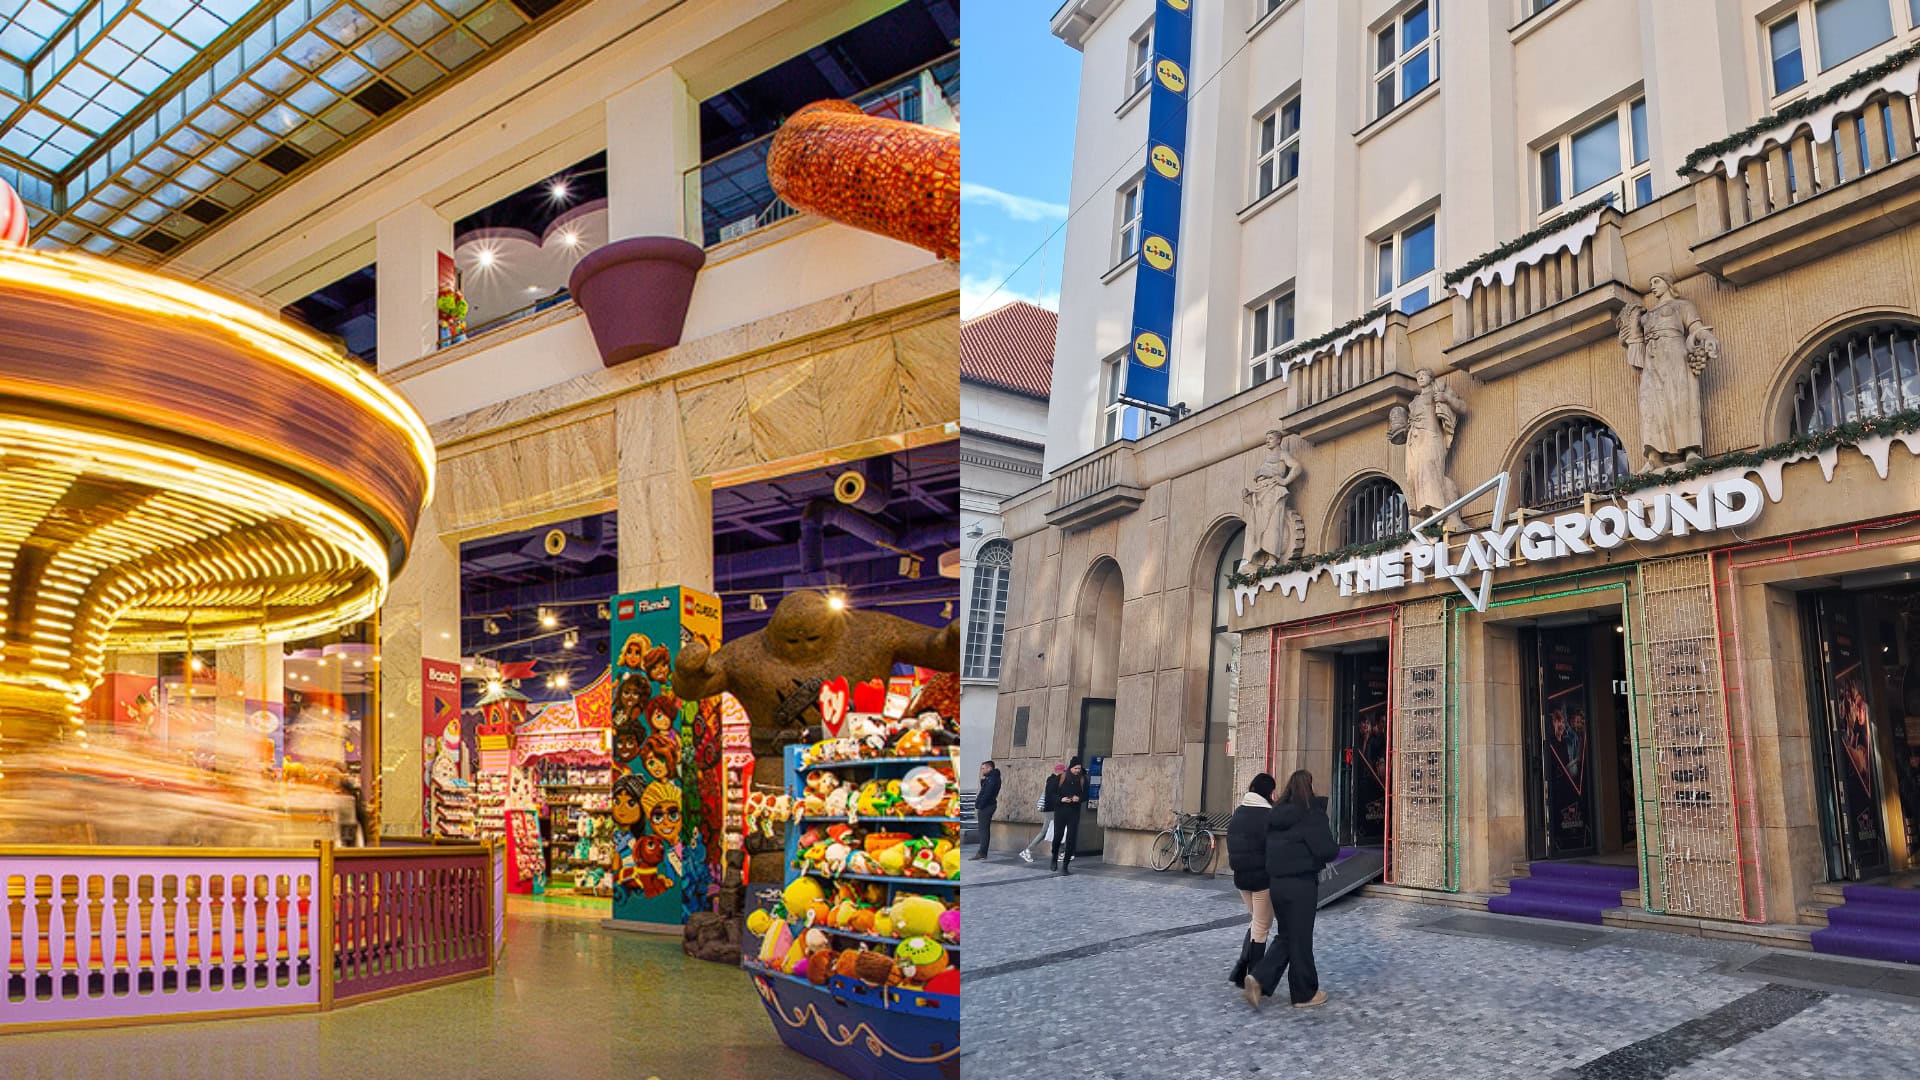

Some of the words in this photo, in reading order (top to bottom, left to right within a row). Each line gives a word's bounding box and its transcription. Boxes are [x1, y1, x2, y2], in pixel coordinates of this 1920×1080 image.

[1334, 550, 1404, 597] THE
[1411, 477, 1764, 583] PLAYGROUND
[820, 685, 845, 725] ty
